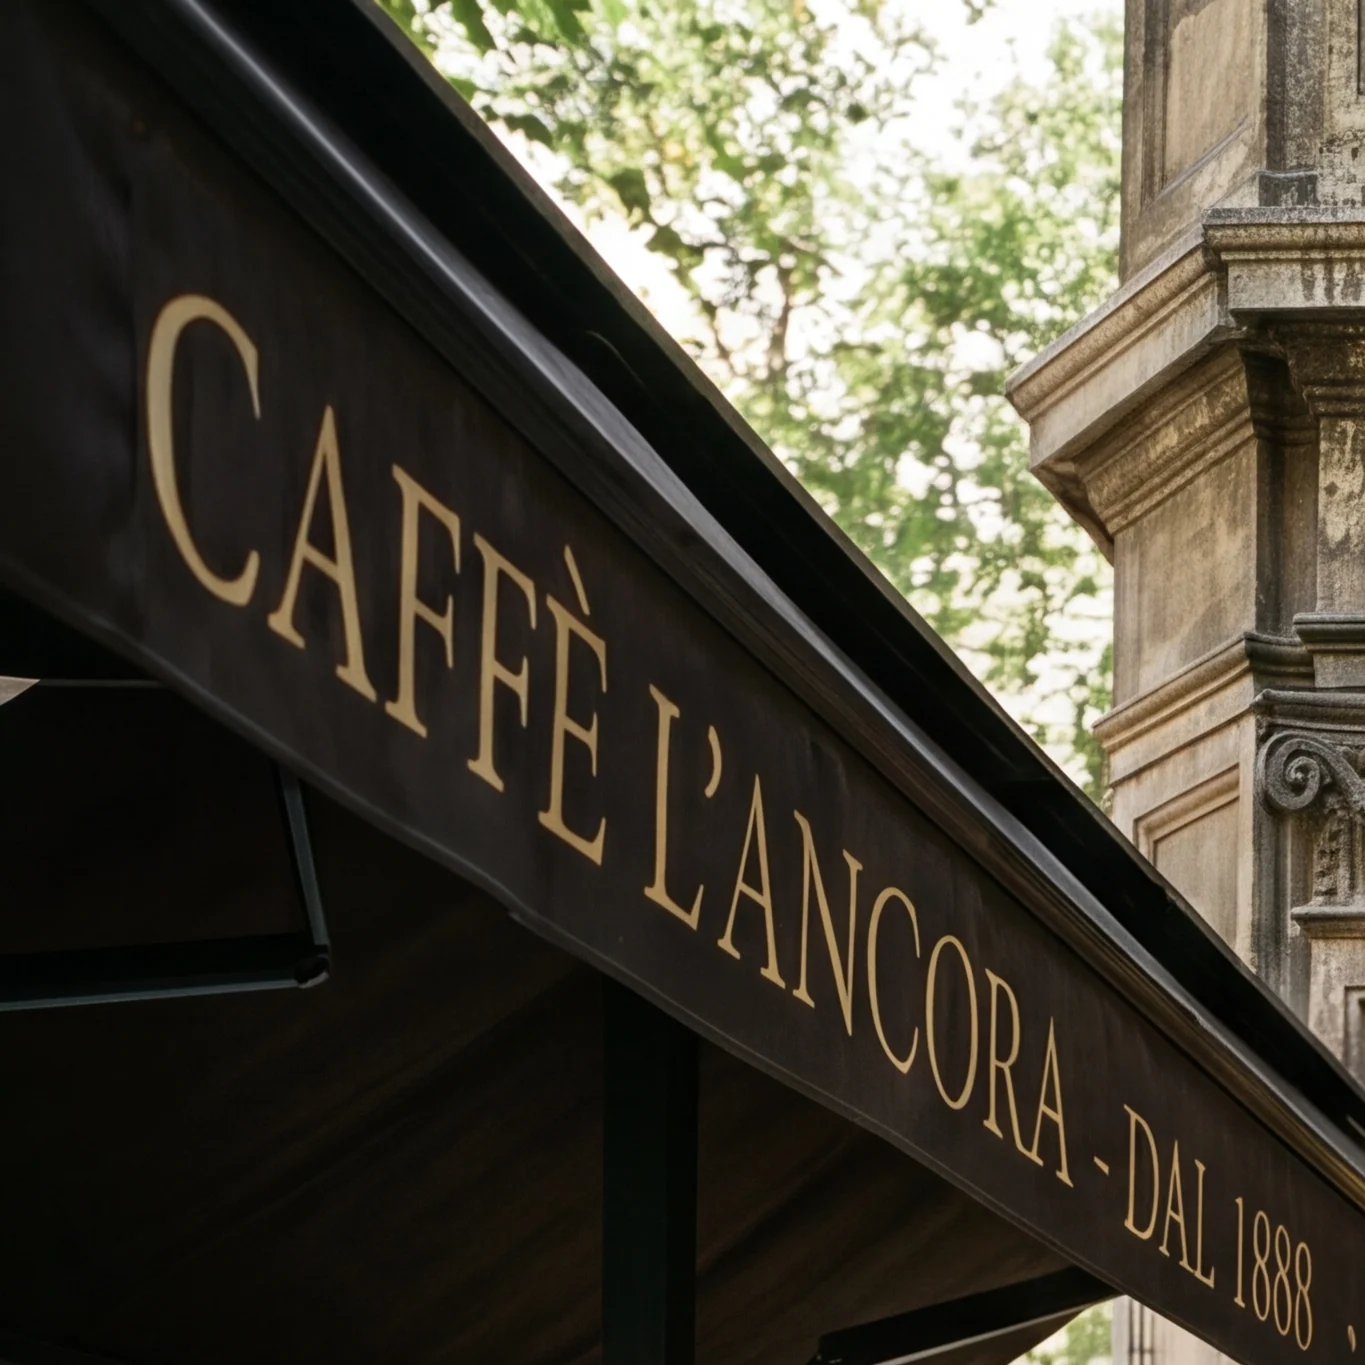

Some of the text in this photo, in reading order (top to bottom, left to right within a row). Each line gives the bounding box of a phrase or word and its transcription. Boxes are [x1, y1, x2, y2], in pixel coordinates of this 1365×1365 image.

[147, 294, 608, 867] CAFFÈ
[644, 684, 1075, 1188] L'ANCORA
[1123, 1103, 1215, 1289] DAL
[1234, 1196, 1314, 1352] 1888
